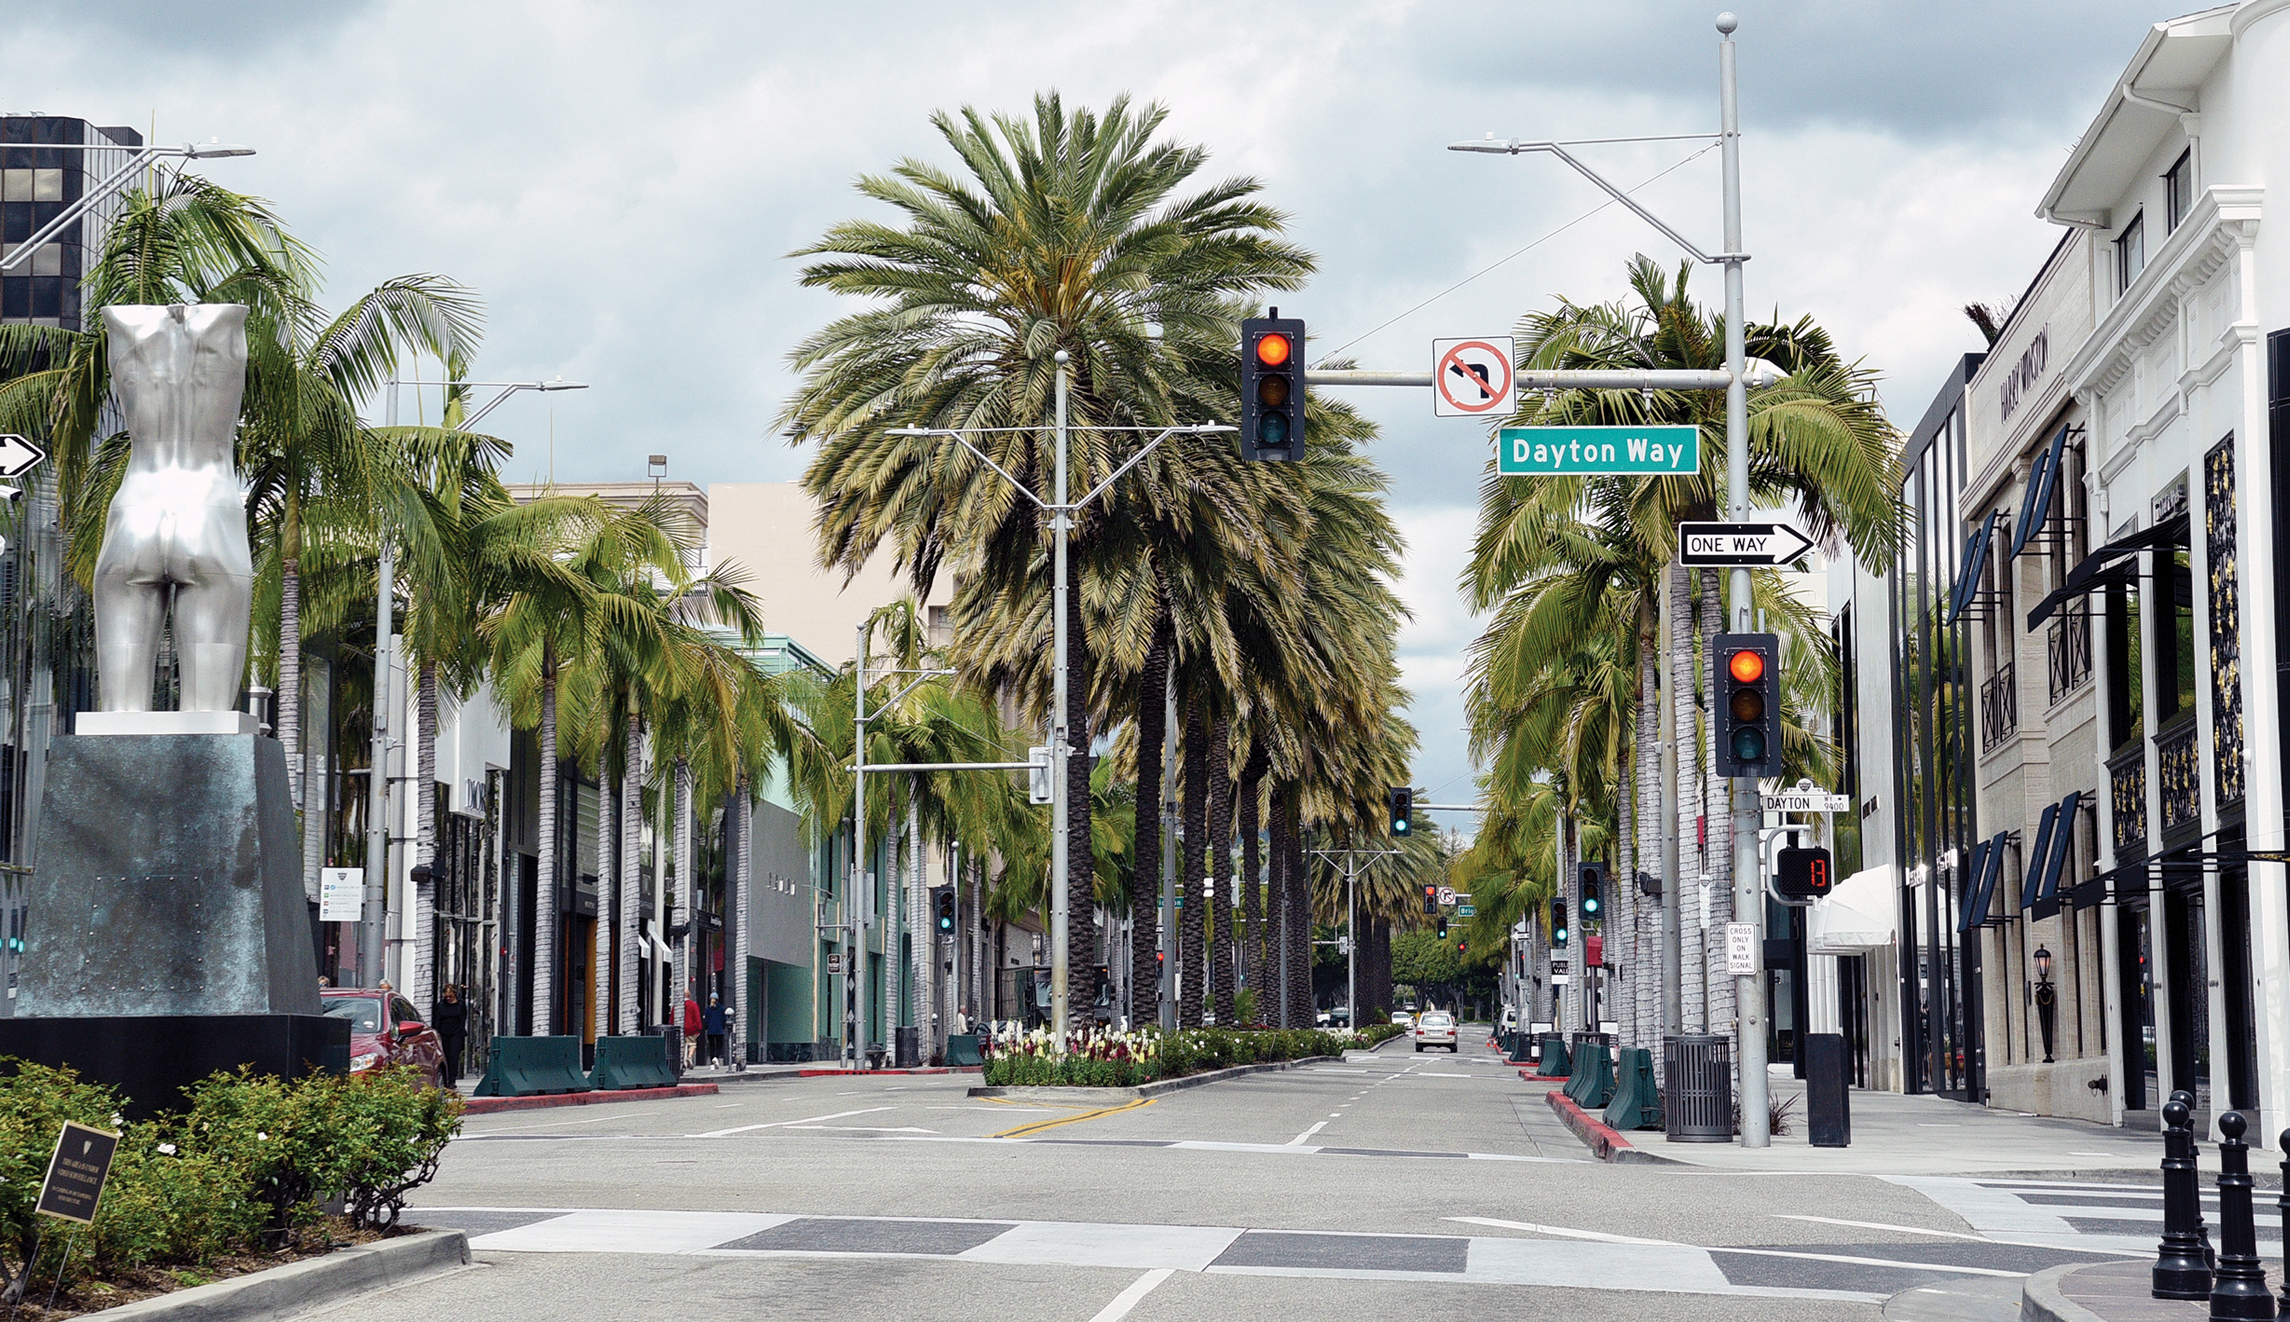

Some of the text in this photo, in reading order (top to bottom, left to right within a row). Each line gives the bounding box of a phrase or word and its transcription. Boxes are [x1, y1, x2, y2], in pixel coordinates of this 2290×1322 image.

[1513, 438, 1684, 469] Dayton Way
[1691, 537, 1767, 552] ONE WAY
[1767, 797, 1810, 810] DAYTON
[1824, 803, 1844, 811] 9400
